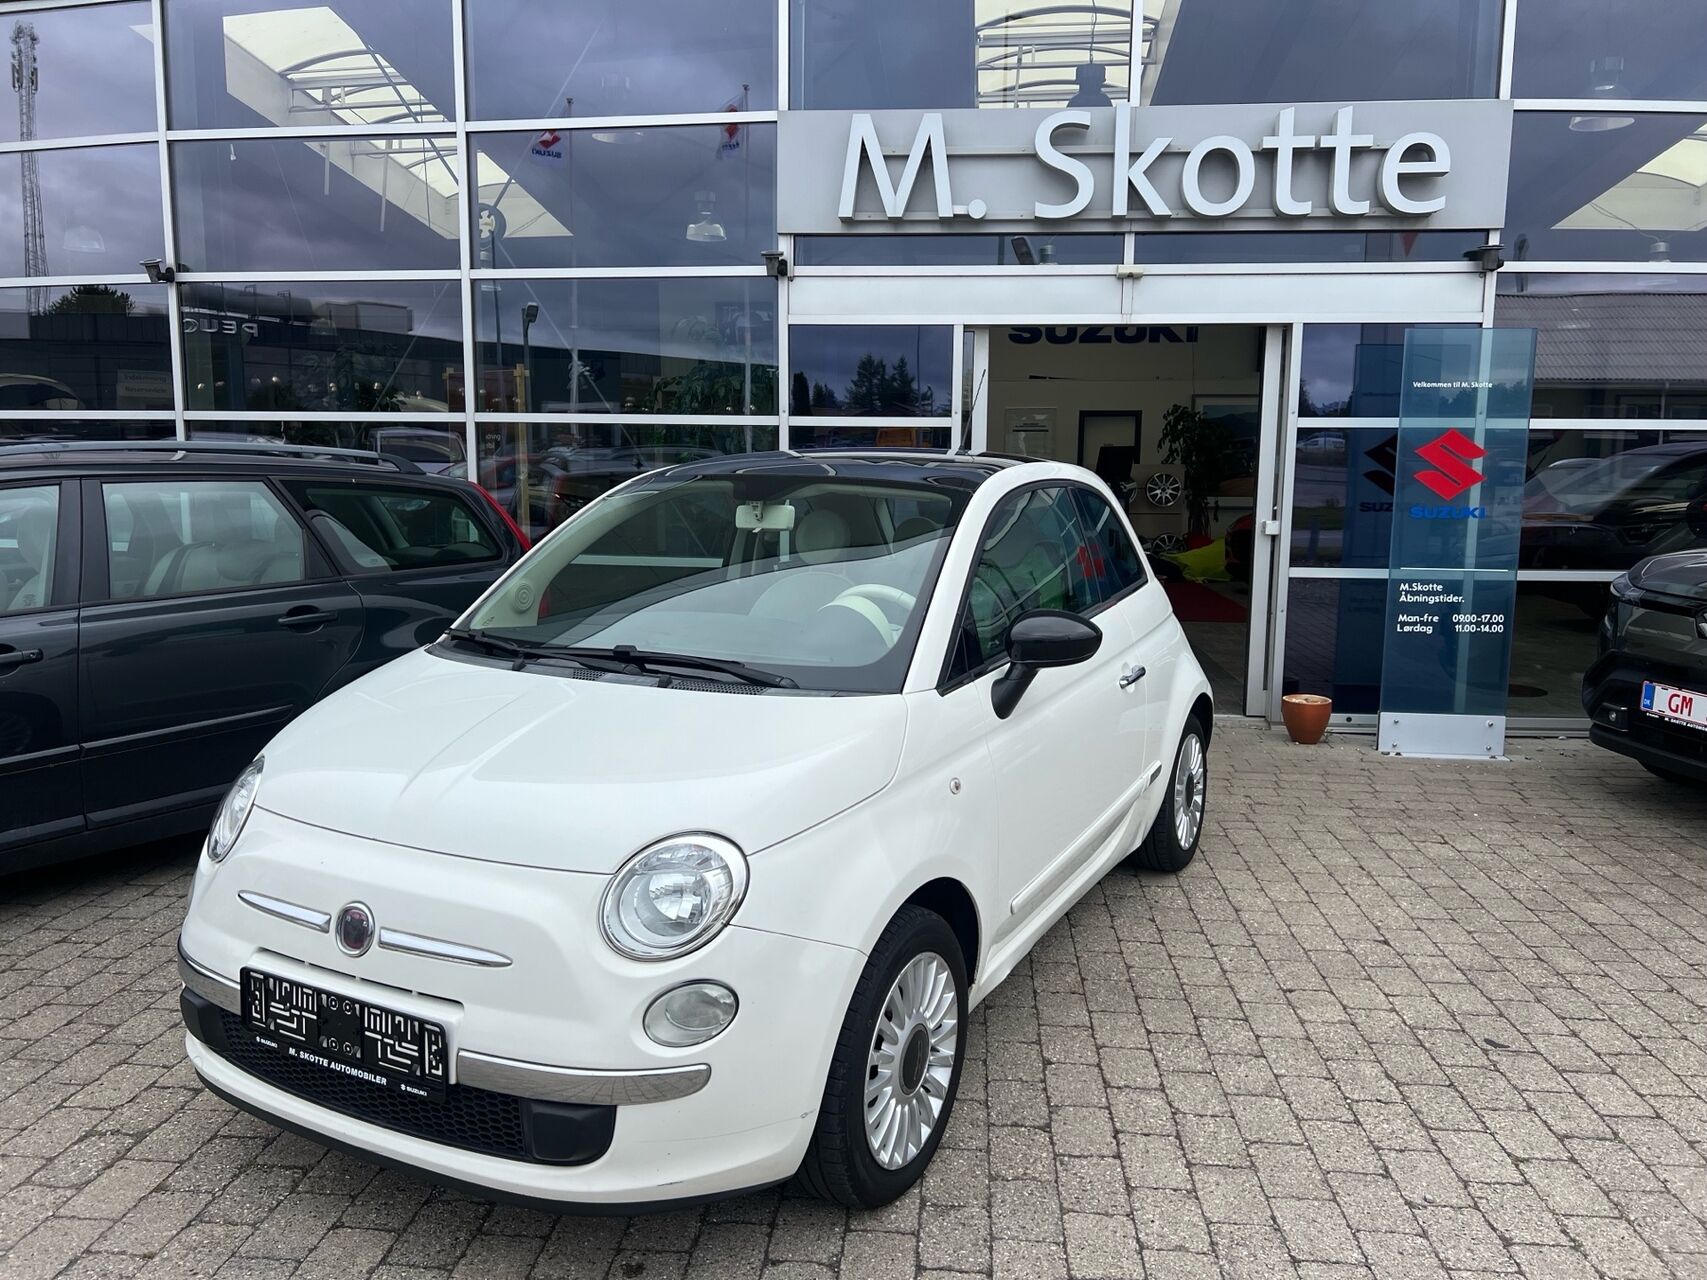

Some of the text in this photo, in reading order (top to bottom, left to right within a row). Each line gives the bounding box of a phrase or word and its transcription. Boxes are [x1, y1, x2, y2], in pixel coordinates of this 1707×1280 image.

[838, 103, 1452, 222] M. Skotte
[1359, 502, 1393, 513] SUZ
[1409, 506, 1486, 519] SUZUKI
[1399, 582, 1444, 592] M.Skotte
[1399, 591, 1465, 604] Åbningstider.
[1397, 613, 1505, 623] Man-fre 09.00-17.00
[1396, 624, 1505, 634] Lørdag 11.00-14.00
[1668, 693, 1694, 717] GM
[288, 1047, 388, 1086] M. SKOTTE AUTOMOBILER
[406, 1086, 428, 1097] SUZUKI
